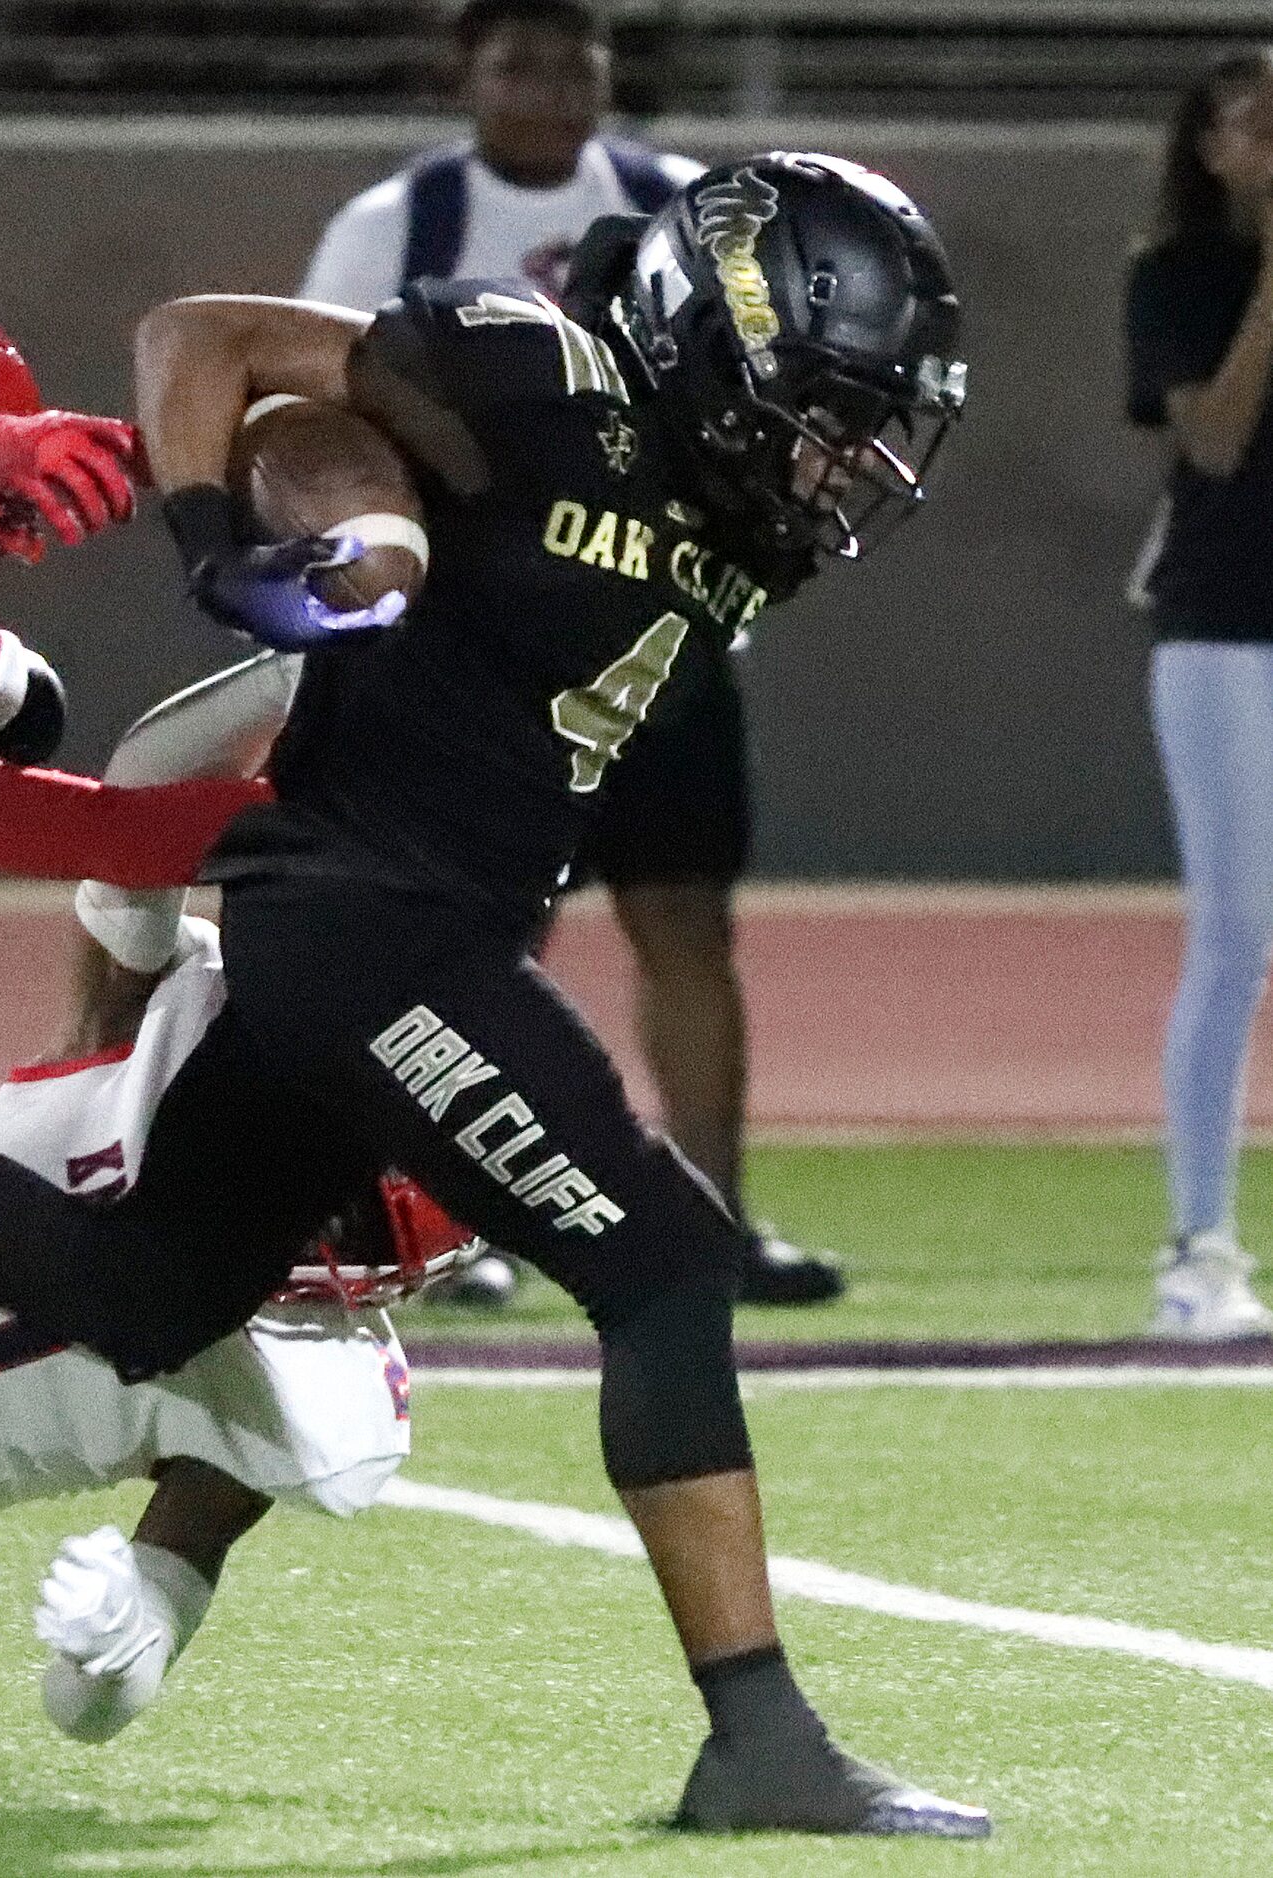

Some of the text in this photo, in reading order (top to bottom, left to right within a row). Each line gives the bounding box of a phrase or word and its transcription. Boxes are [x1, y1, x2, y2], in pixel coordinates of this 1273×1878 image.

[543, 500, 655, 580] OAK
[551, 611, 689, 793] 4
[369, 1004, 626, 1236] OAK CLIFF
